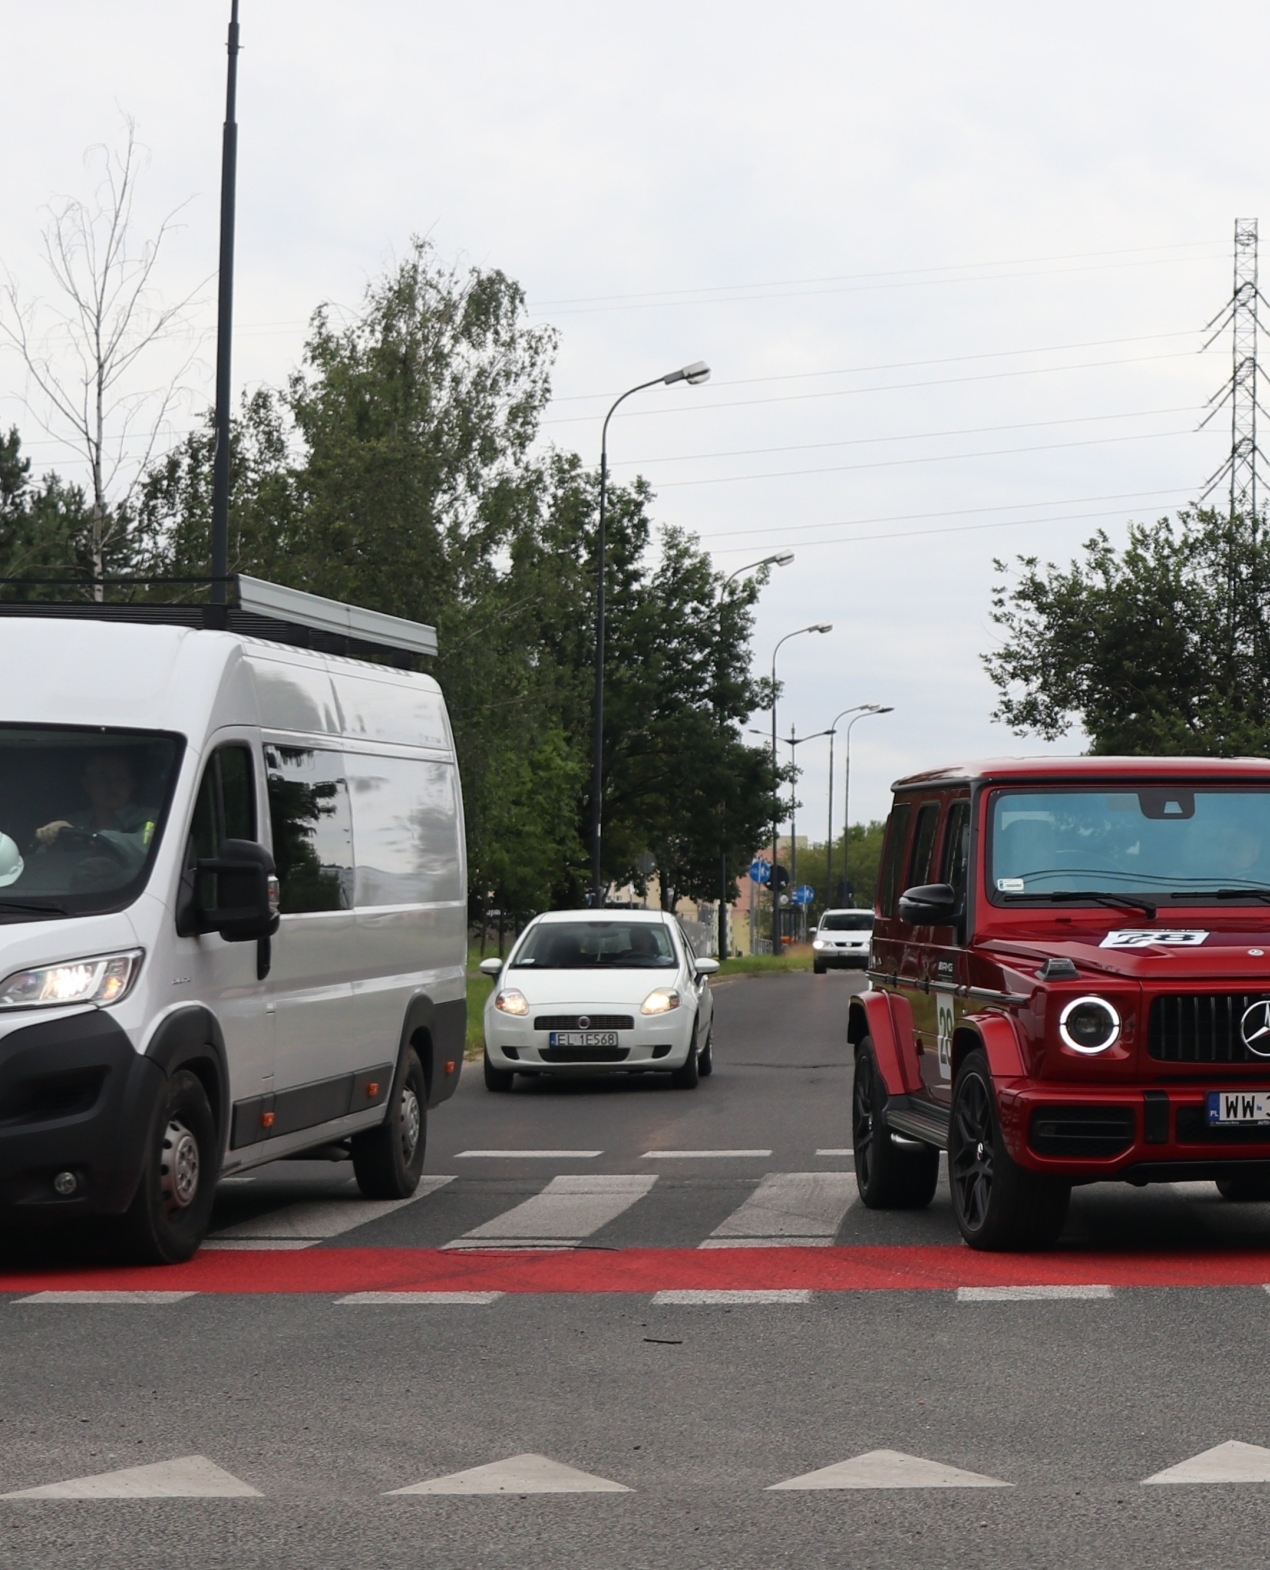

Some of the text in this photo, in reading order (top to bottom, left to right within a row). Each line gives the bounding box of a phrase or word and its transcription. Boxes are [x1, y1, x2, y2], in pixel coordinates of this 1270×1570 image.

[557, 1034, 615, 1046] EL 1E568
[1225, 1095, 1255, 1119] WW
